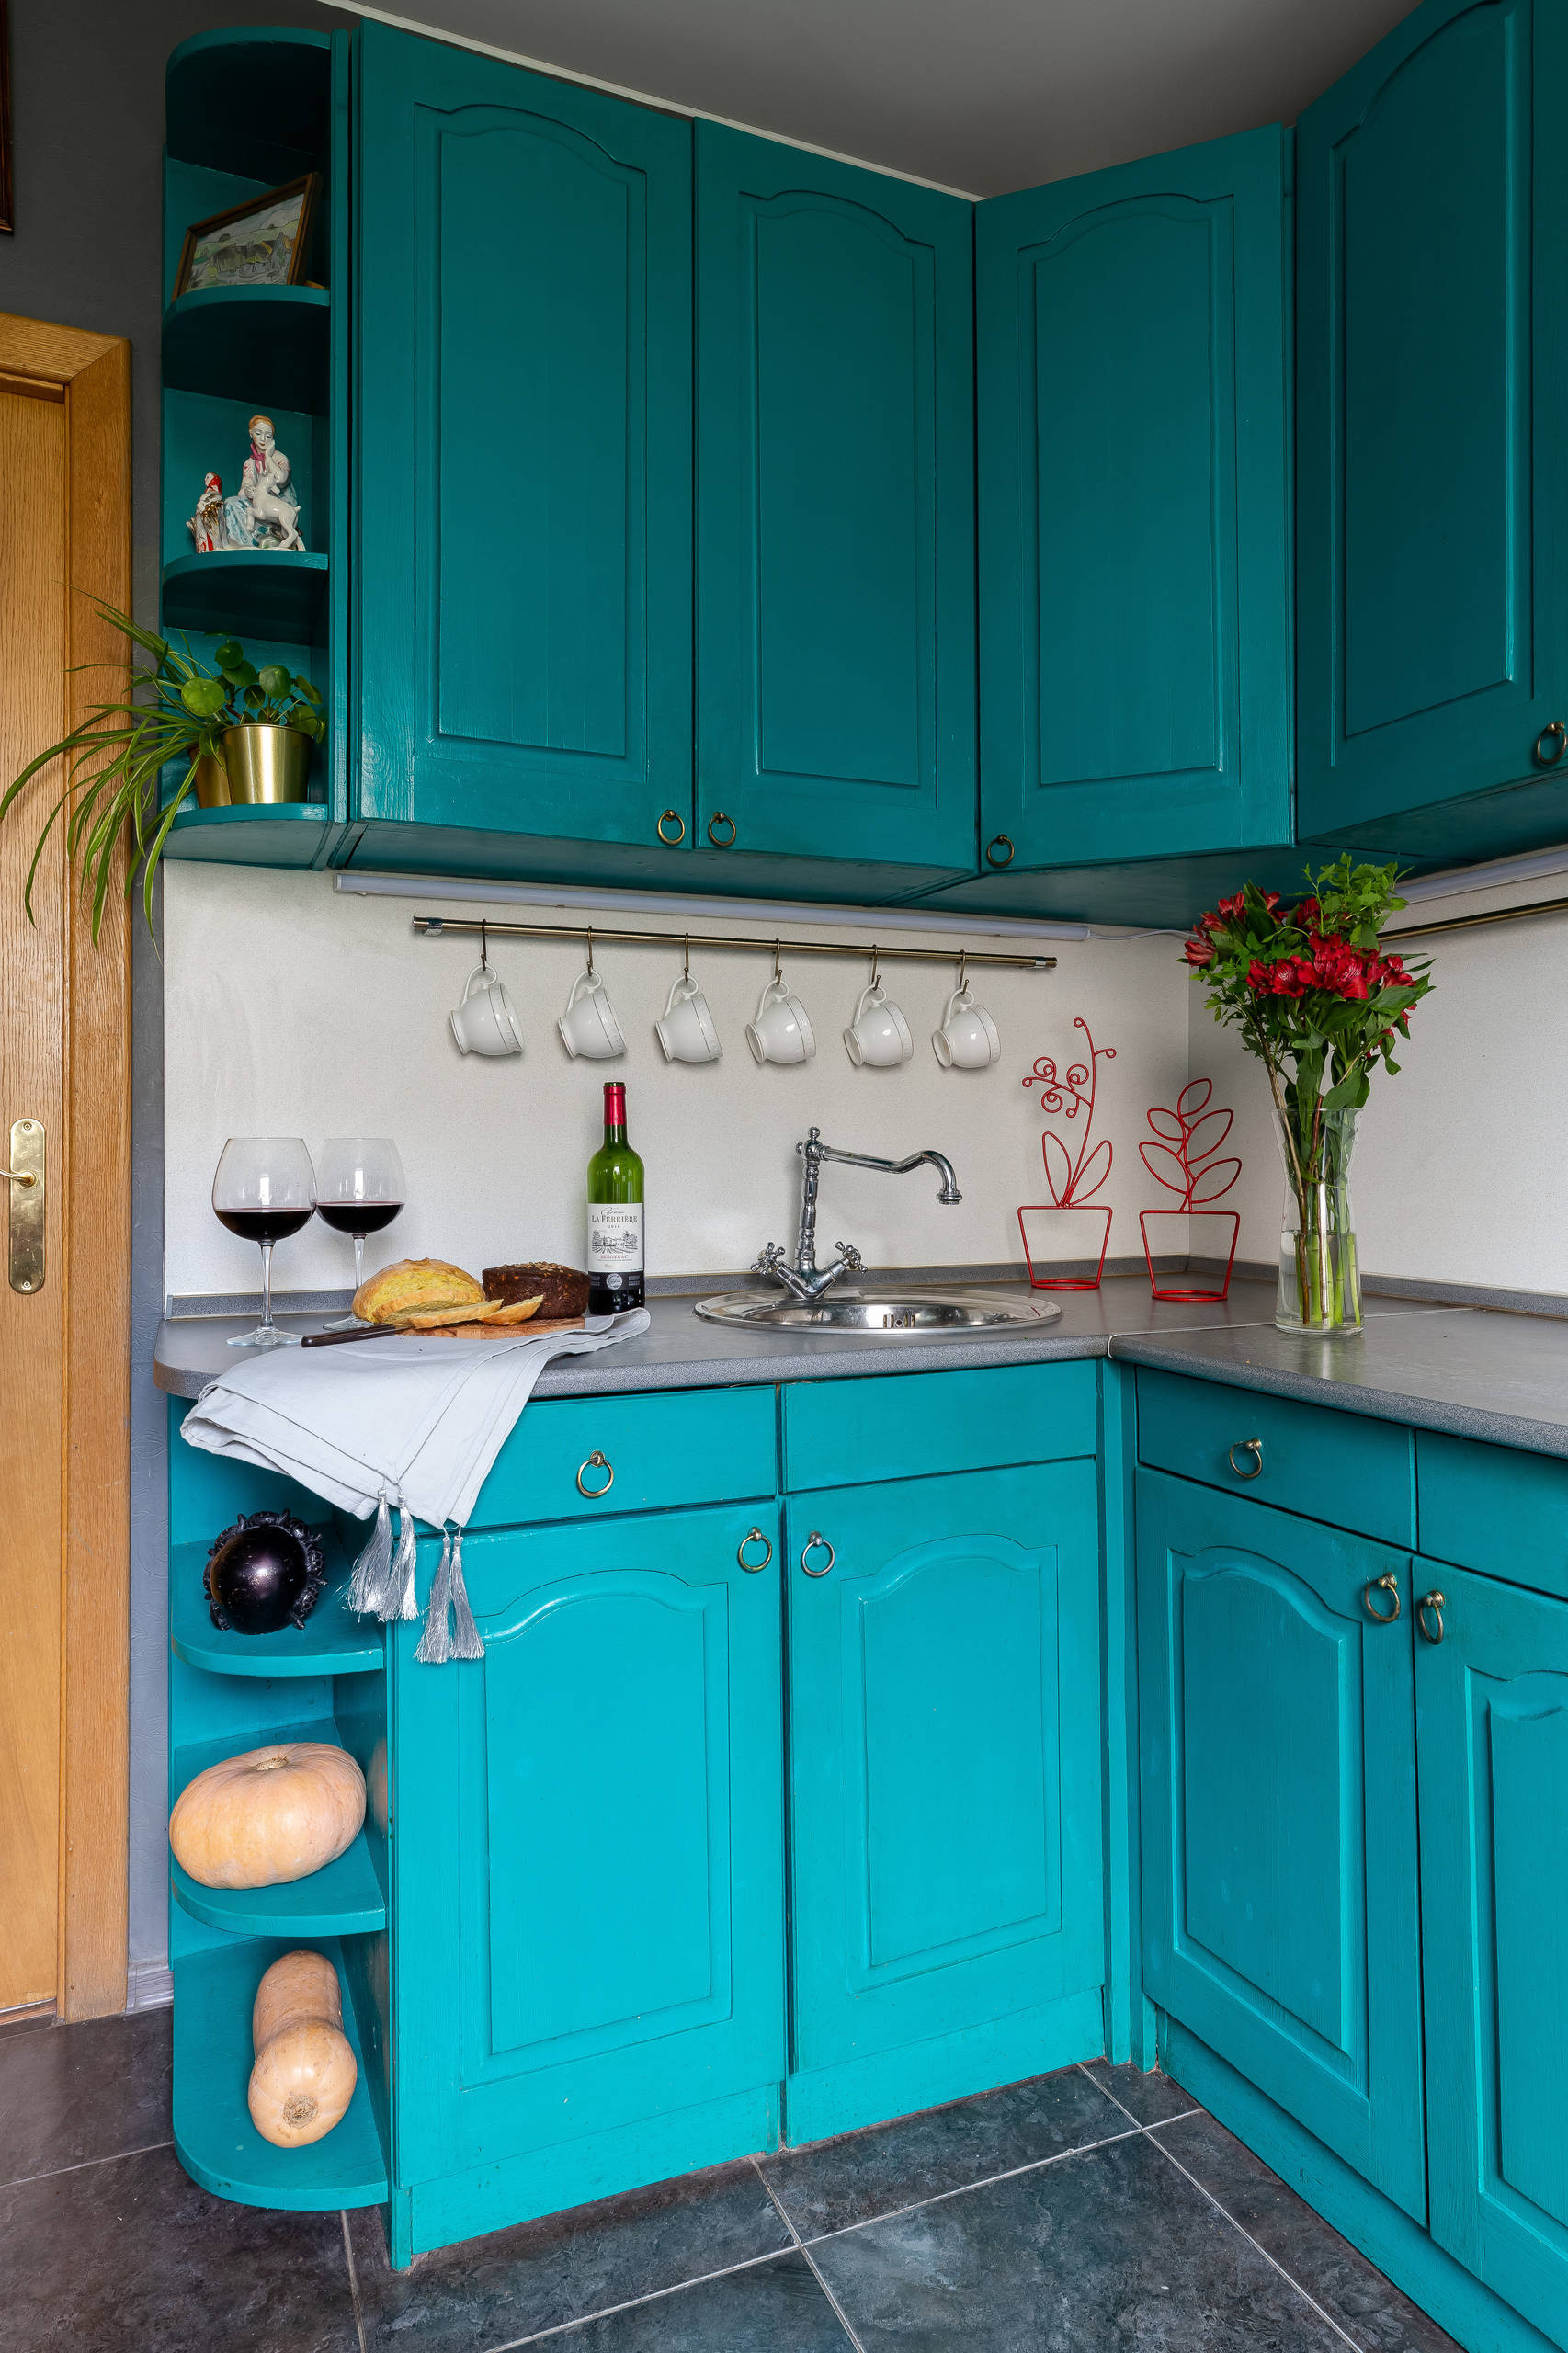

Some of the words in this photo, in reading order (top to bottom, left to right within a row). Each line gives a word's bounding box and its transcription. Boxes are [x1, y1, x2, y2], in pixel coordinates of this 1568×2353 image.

[600, 1206, 625, 1215] Chât
[591, 1215, 600, 1223] LA
[601, 1214, 638, 1223] FERRIÈRE
